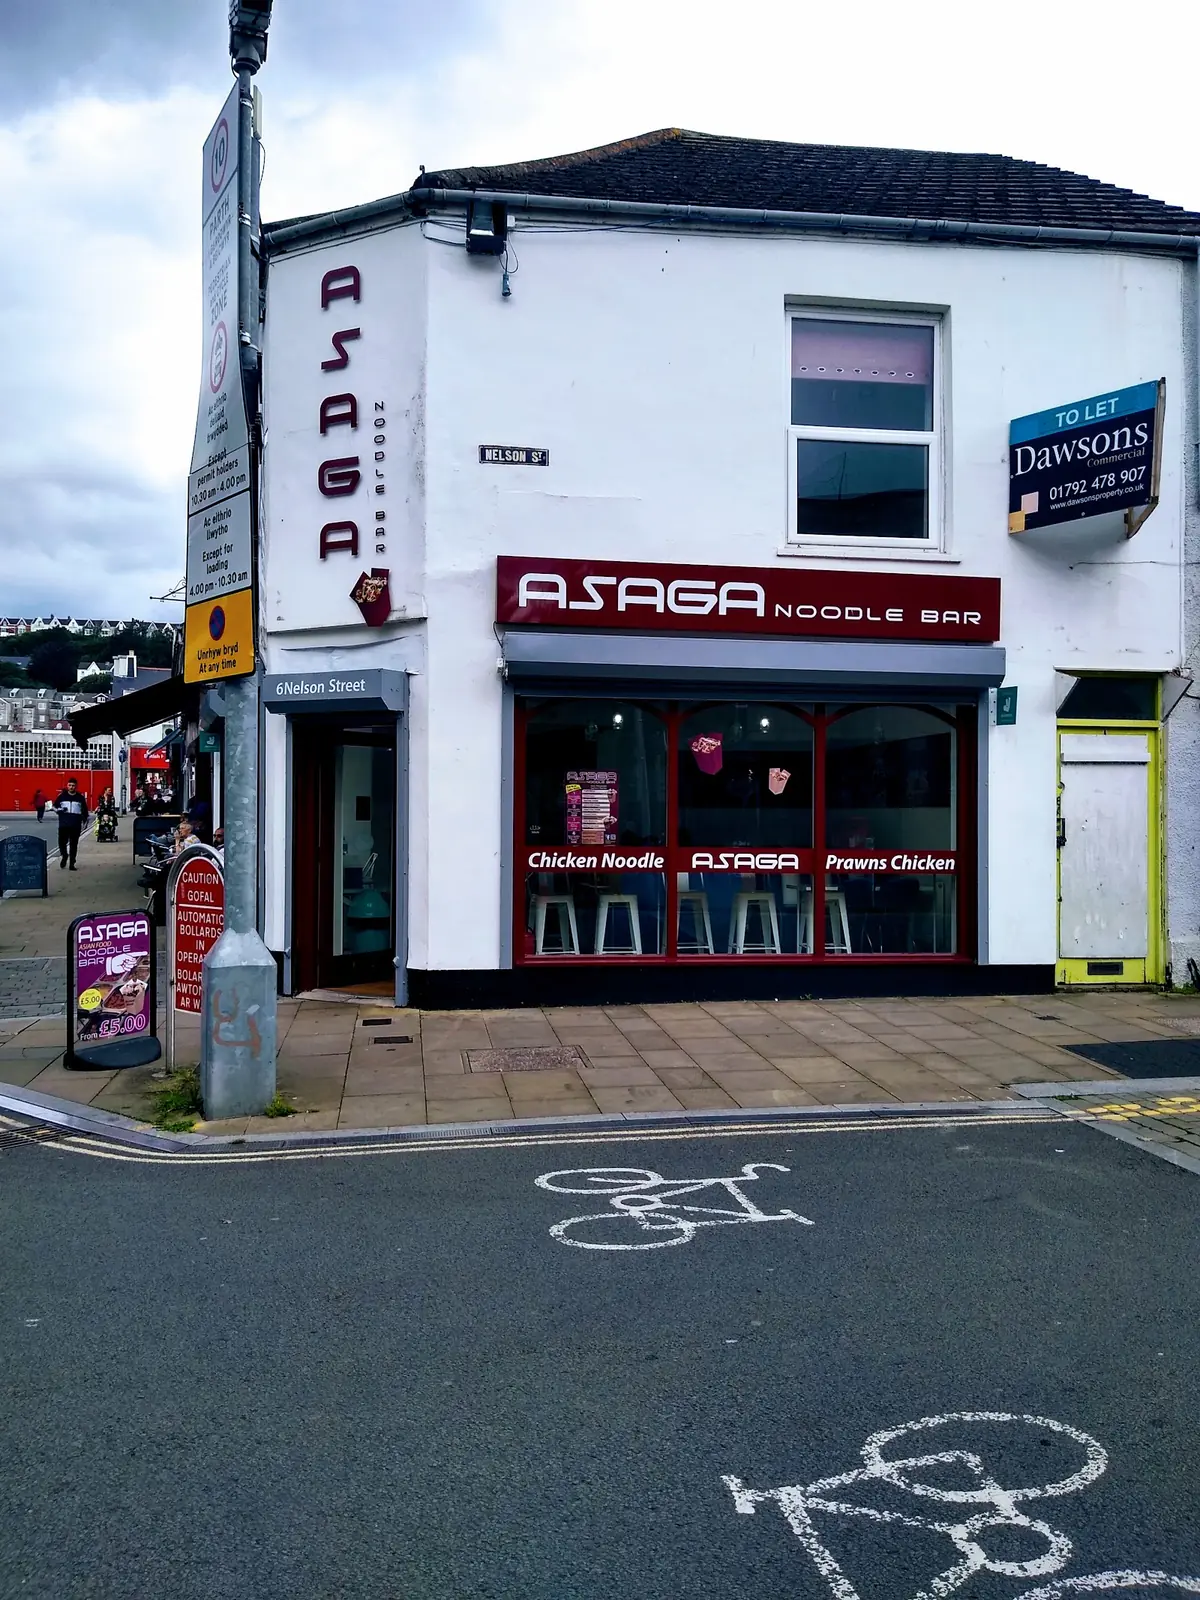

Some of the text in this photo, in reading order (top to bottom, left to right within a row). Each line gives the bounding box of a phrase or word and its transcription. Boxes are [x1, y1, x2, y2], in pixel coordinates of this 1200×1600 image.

[214, 138, 225, 174] 10
[210, 196, 230, 240] PARTH
[210, 288, 228, 326] ZONE
[318, 265, 361, 561] ASAGA
[1056, 398, 1119, 427] TO LET
[208, 448, 227, 467] Except
[485, 449, 526, 462] NELSON
[1015, 422, 1148, 476] Dawsons
[1087, 446, 1145, 468] Commercial
[197, 458, 238, 488] permit holders
[374, 400, 385, 553] NOODLE BAR
[191, 489, 207, 506] 10.30
[208, 486, 216, 498] am
[220, 479, 236, 494] 4.00
[236, 473, 246, 485] pm
[1050, 466, 1146, 500] 01792 478 907
[1050, 483, 1144, 510] www.dawsonsproperty.co.uk
[204, 508, 232, 528] Ac eithrio
[206, 524, 228, 540] llwytho
[202, 543, 233, 562] Except for
[206, 560, 228, 575] loading
[190, 583, 204, 596] 4.00
[204, 580, 214, 592] pm
[218, 572, 236, 587] 10.30
[238, 571, 248, 581] am
[518, 573, 982, 624] ASAGA NOODLE BAR
[197, 642, 238, 660] Unrhyw bryd
[199, 658, 236, 674] At any time
[329, 679, 366, 692] Street
[567, 771, 617, 781] ASAGA
[528, 852, 664, 869] Chicken Noodle
[692, 852, 799, 870] ASAGA
[825, 854, 955, 870] Prawns Chicken
[182, 872, 219, 885] CAUTION
[188, 890, 214, 903] GOFAL
[177, 910, 224, 926] AUTOMATIC
[78, 920, 148, 943] ASAGA
[180, 924, 222, 938] BOLLARDS
[78, 944, 131, 958] NOODLE
[96, 941, 112, 949] FOOD
[196, 939, 205, 951] IN
[78, 956, 106, 967] BAR
[80, 995, 100, 1006] £5.00
[180, 997, 191, 1008] AR
[80, 1014, 146, 1040] From £5.00
